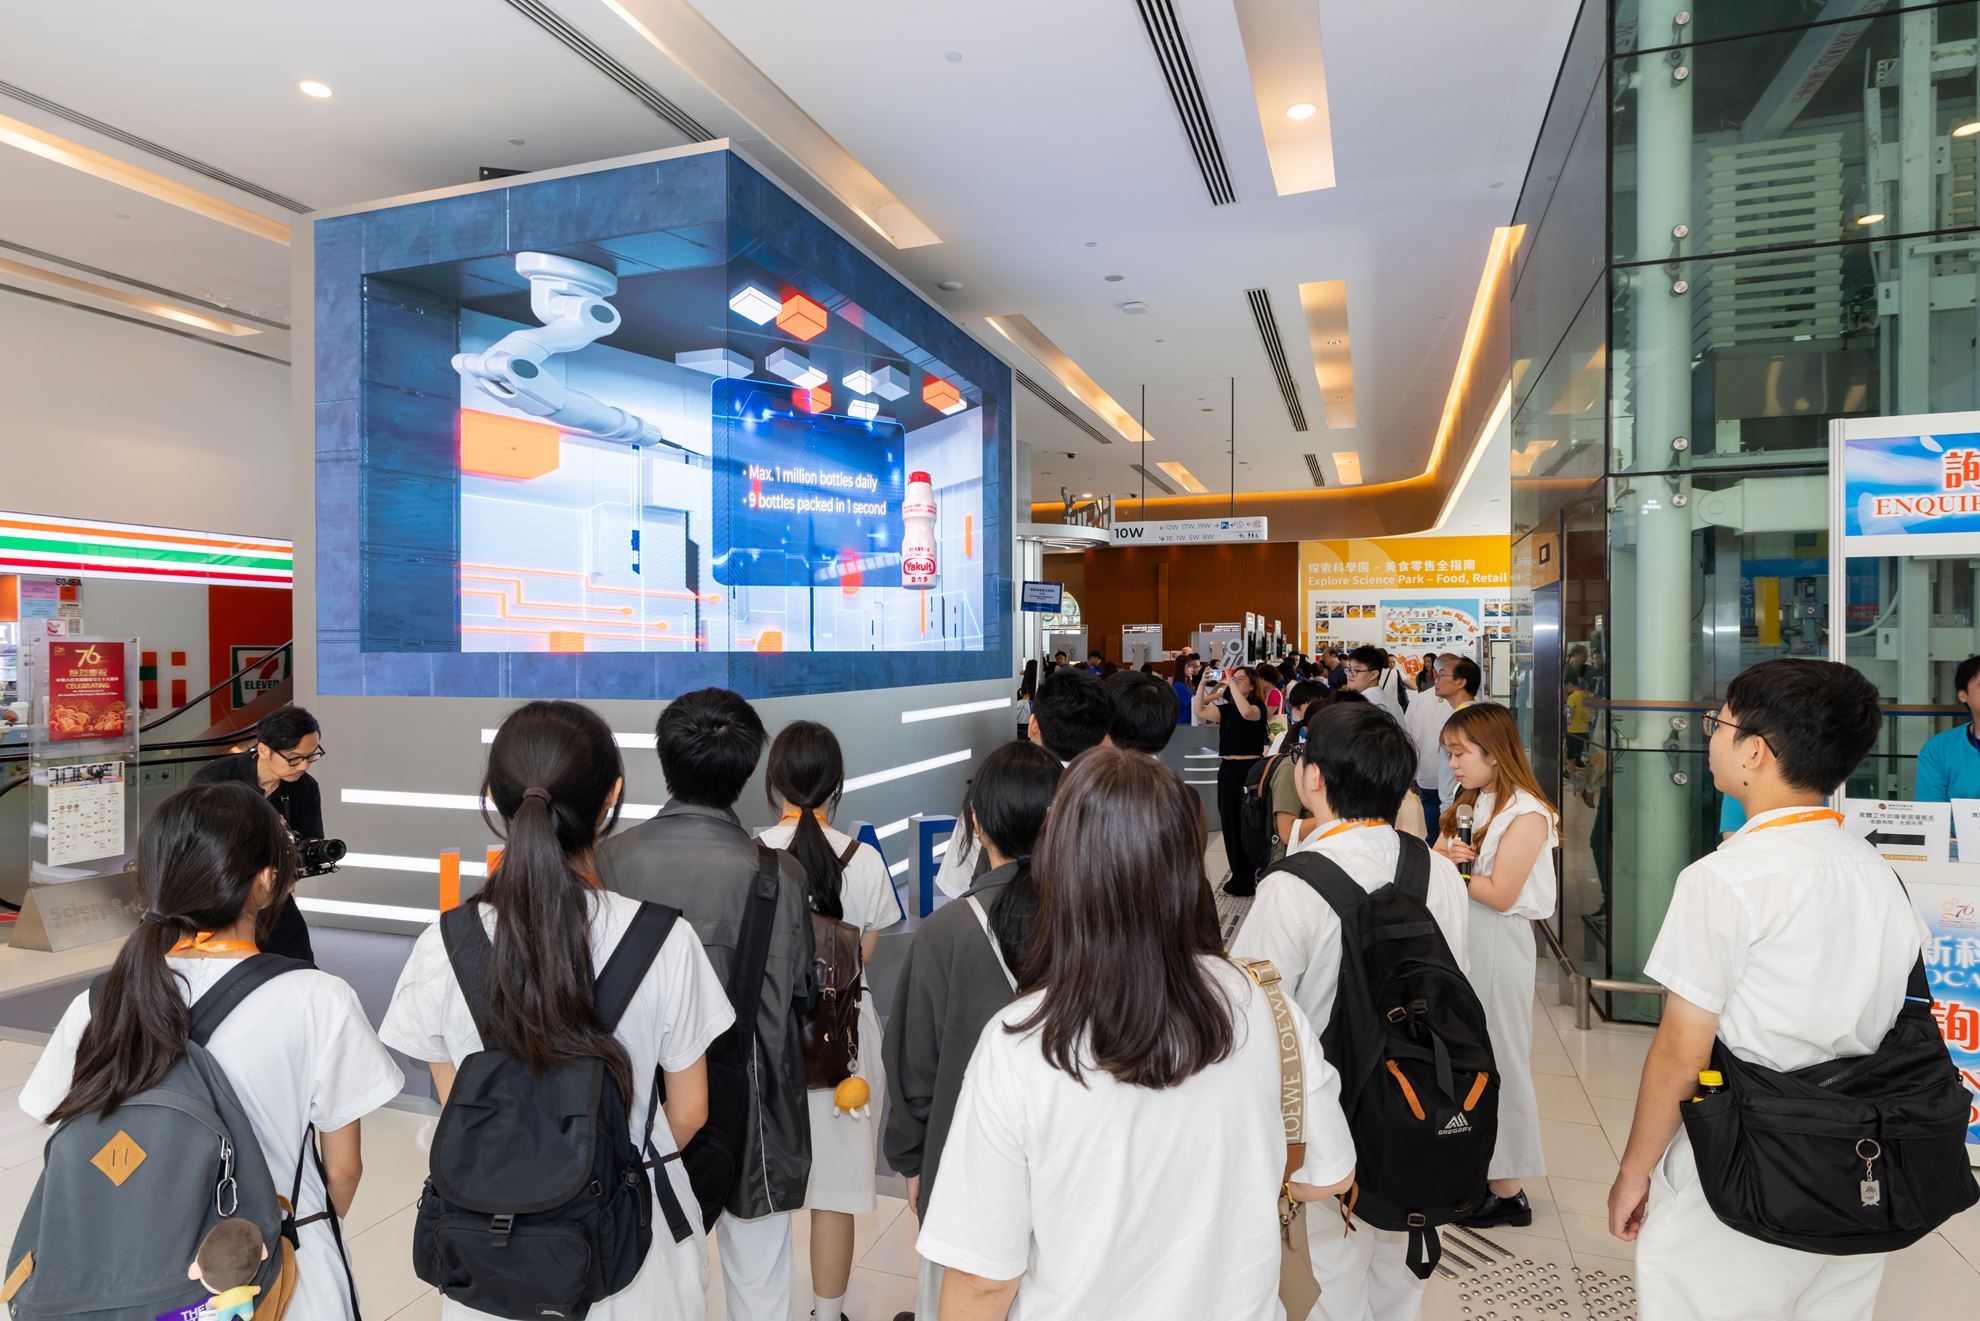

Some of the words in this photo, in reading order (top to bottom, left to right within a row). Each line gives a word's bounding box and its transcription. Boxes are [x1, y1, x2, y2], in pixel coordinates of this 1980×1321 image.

[749, 465, 774, 481] Max.
[775, 467, 780, 482] 1
[783, 468, 818, 485] million
[820, 470, 854, 488] bottles
[855, 473, 878, 492] daily
[749, 492, 756, 508] 9
[759, 492, 795, 509] bottles
[797, 496, 833, 514] packed
[836, 498, 845, 513] in
[847, 499, 851, 514] 1
[853, 501, 887, 515] second
[1114, 527, 1144, 539] 10W
[906, 562, 932, 571] Yakult
[1308, 576, 1349, 588] Explore
[1352, 575, 1395, 585] Science
[1398, 574, 1424, 584] Park
[1437, 573, 1470, 584] Food,
[1473, 572, 1507, 583] Retail
[75, 644, 101, 667] 76
[1283, 1072, 1301, 1141] LOEWE
[1438, 1126, 1472, 1136] GREGORY
